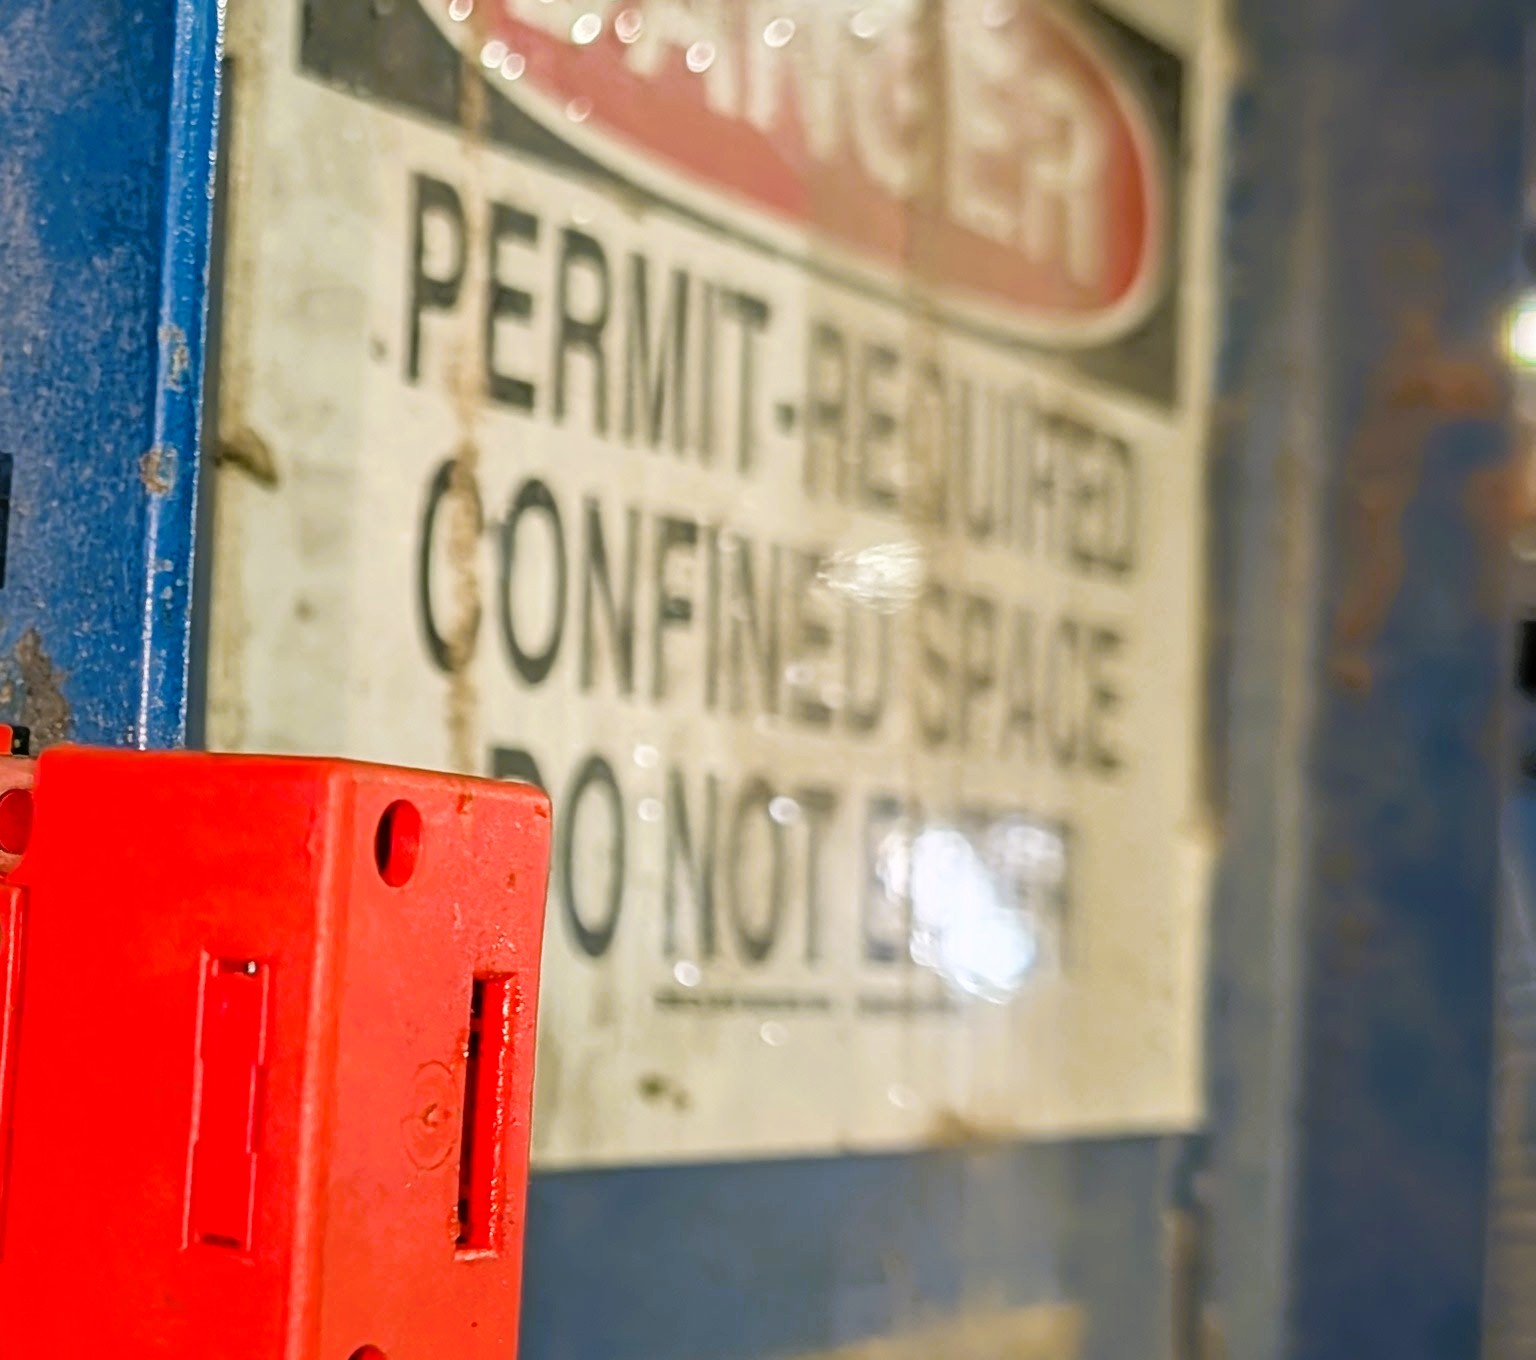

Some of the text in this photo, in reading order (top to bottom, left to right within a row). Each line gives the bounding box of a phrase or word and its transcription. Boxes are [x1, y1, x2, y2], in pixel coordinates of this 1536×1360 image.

[416, 459, 1124, 773] CONFINED SPACE
[666, 765, 840, 964] NOT
